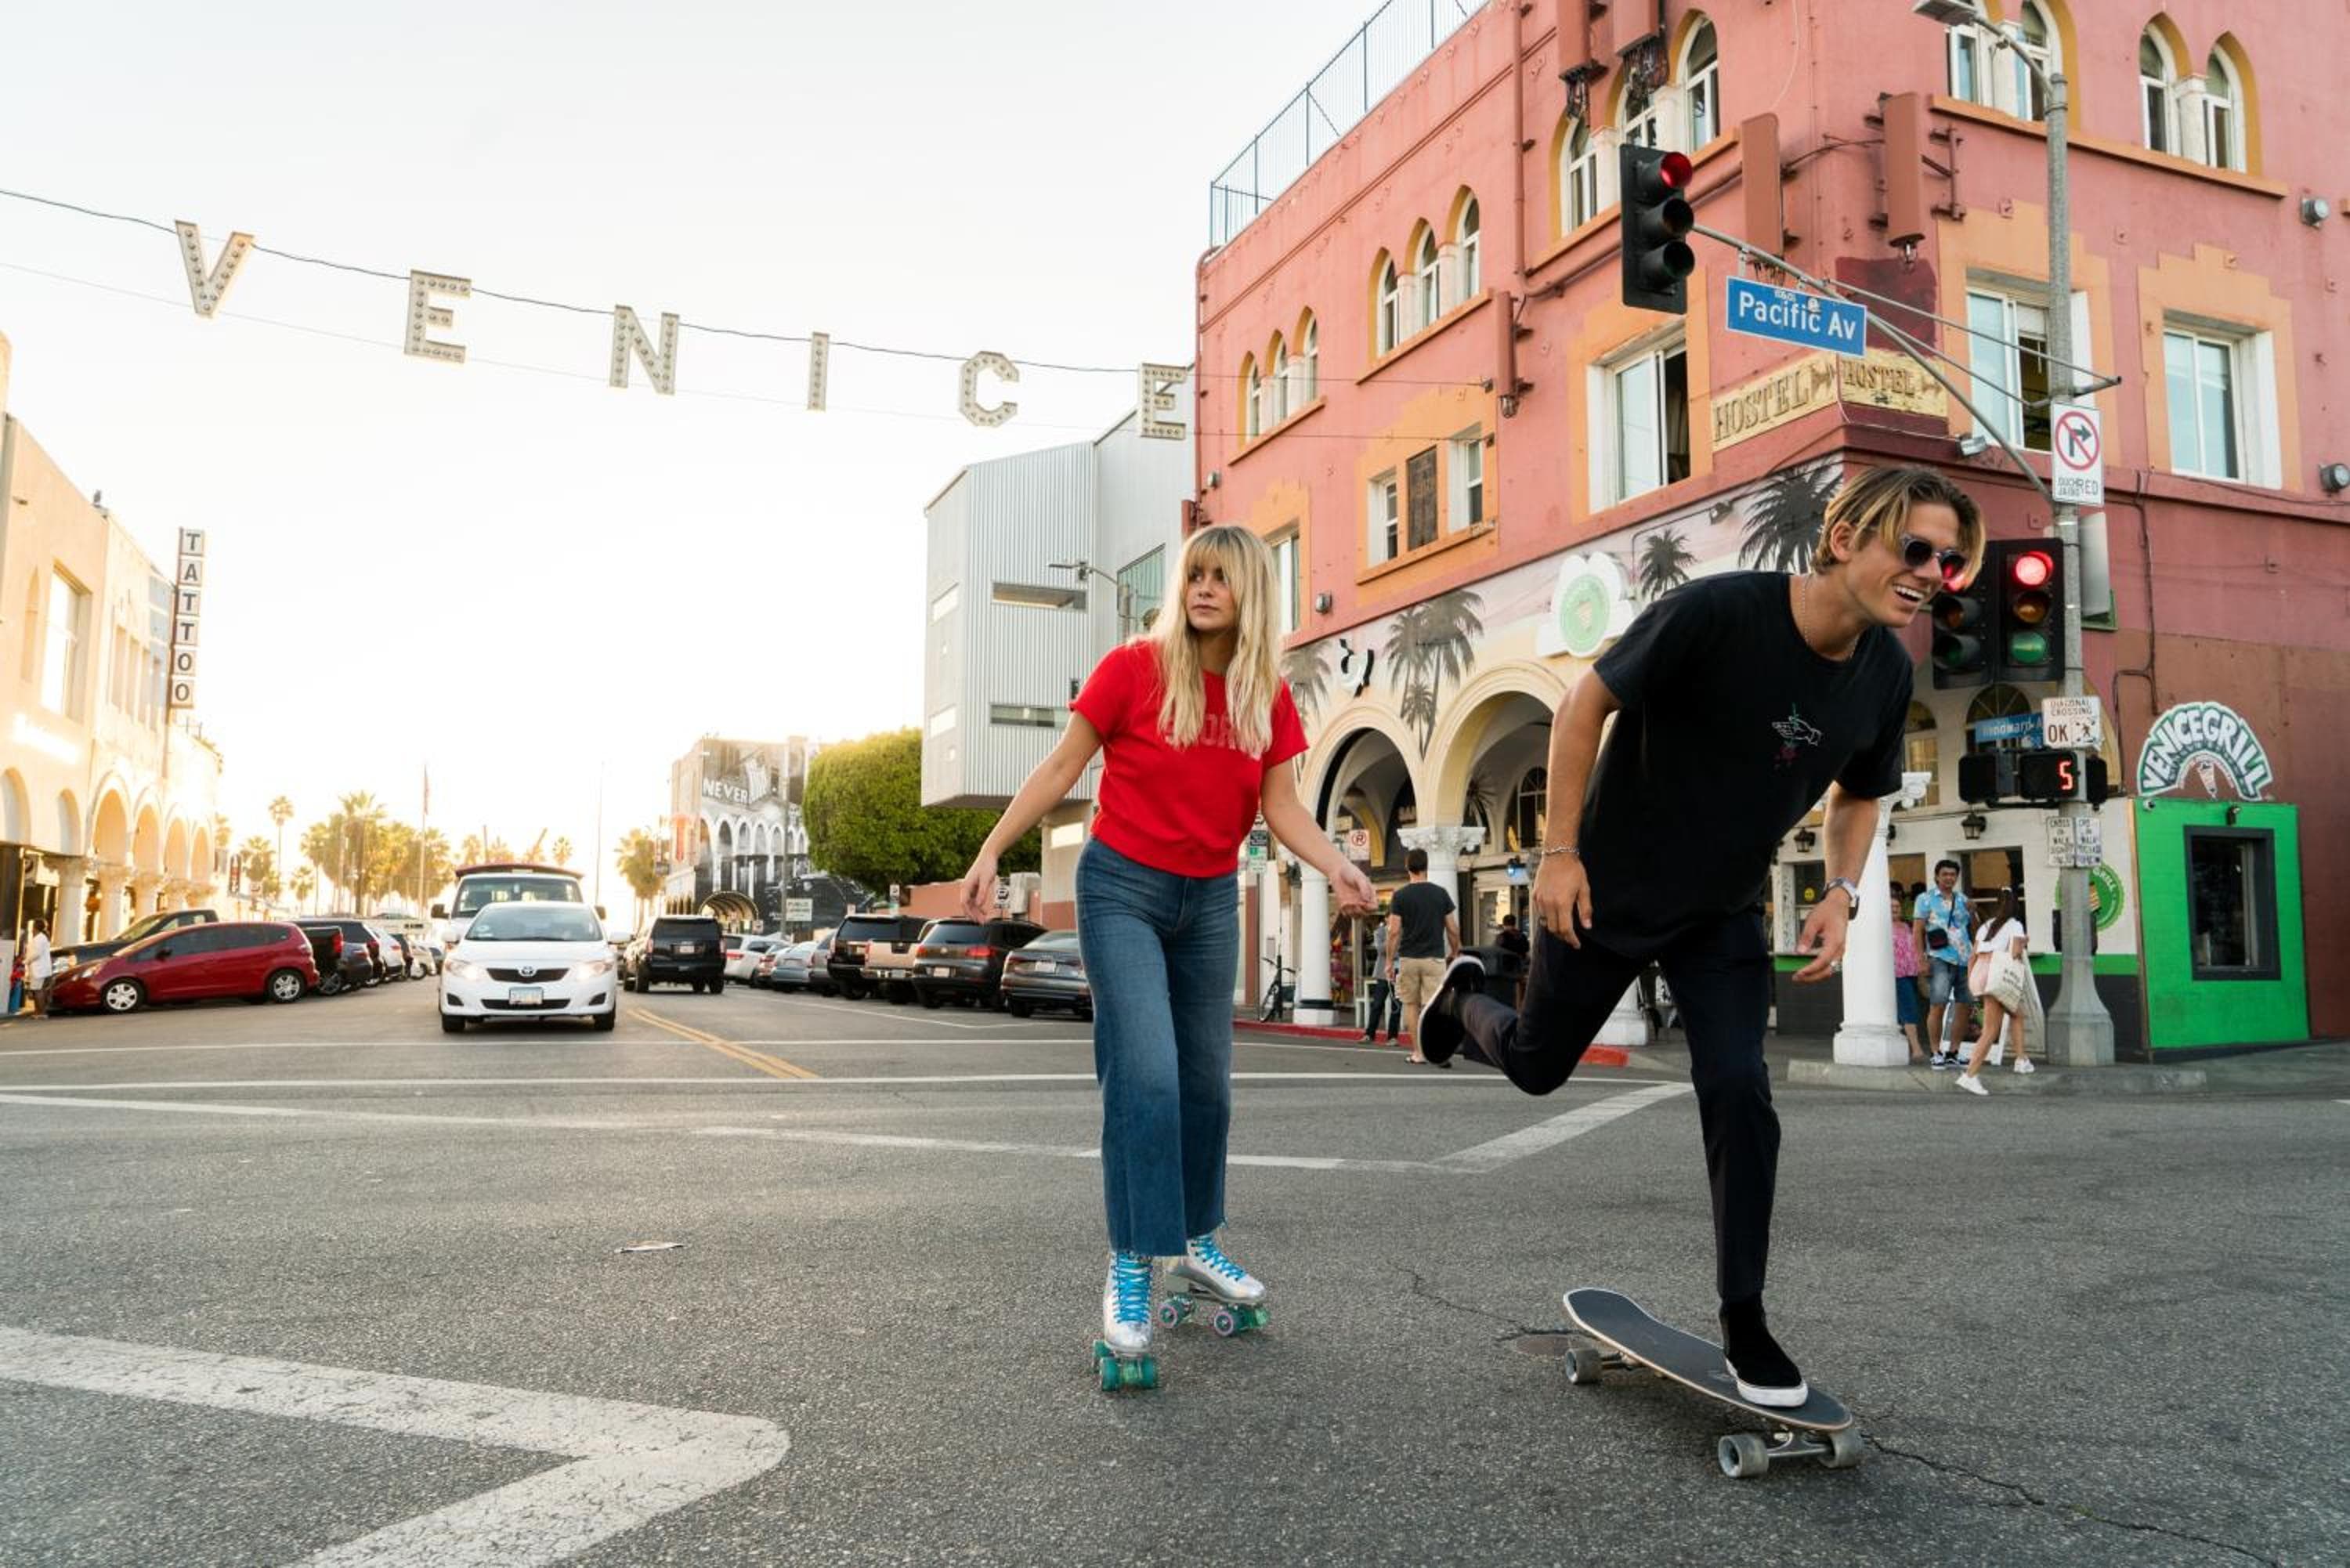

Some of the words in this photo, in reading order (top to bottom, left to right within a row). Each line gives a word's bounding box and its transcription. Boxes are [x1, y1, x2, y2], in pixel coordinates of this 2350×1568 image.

[175, 220, 1188, 440] VENICE
[1739, 291, 1820, 333] Pacific
[1828, 311, 1856, 340] Av
[1843, 360, 1916, 396] HOSTEL
[1714, 370, 1810, 442] HOSTEL
[175, 533, 201, 701] TATTOO
[2051, 707, 2092, 716] CROSSING
[2048, 724, 2069, 743] OK
[703, 777, 748, 804] NEVER
[2059, 761, 2073, 790] 5
